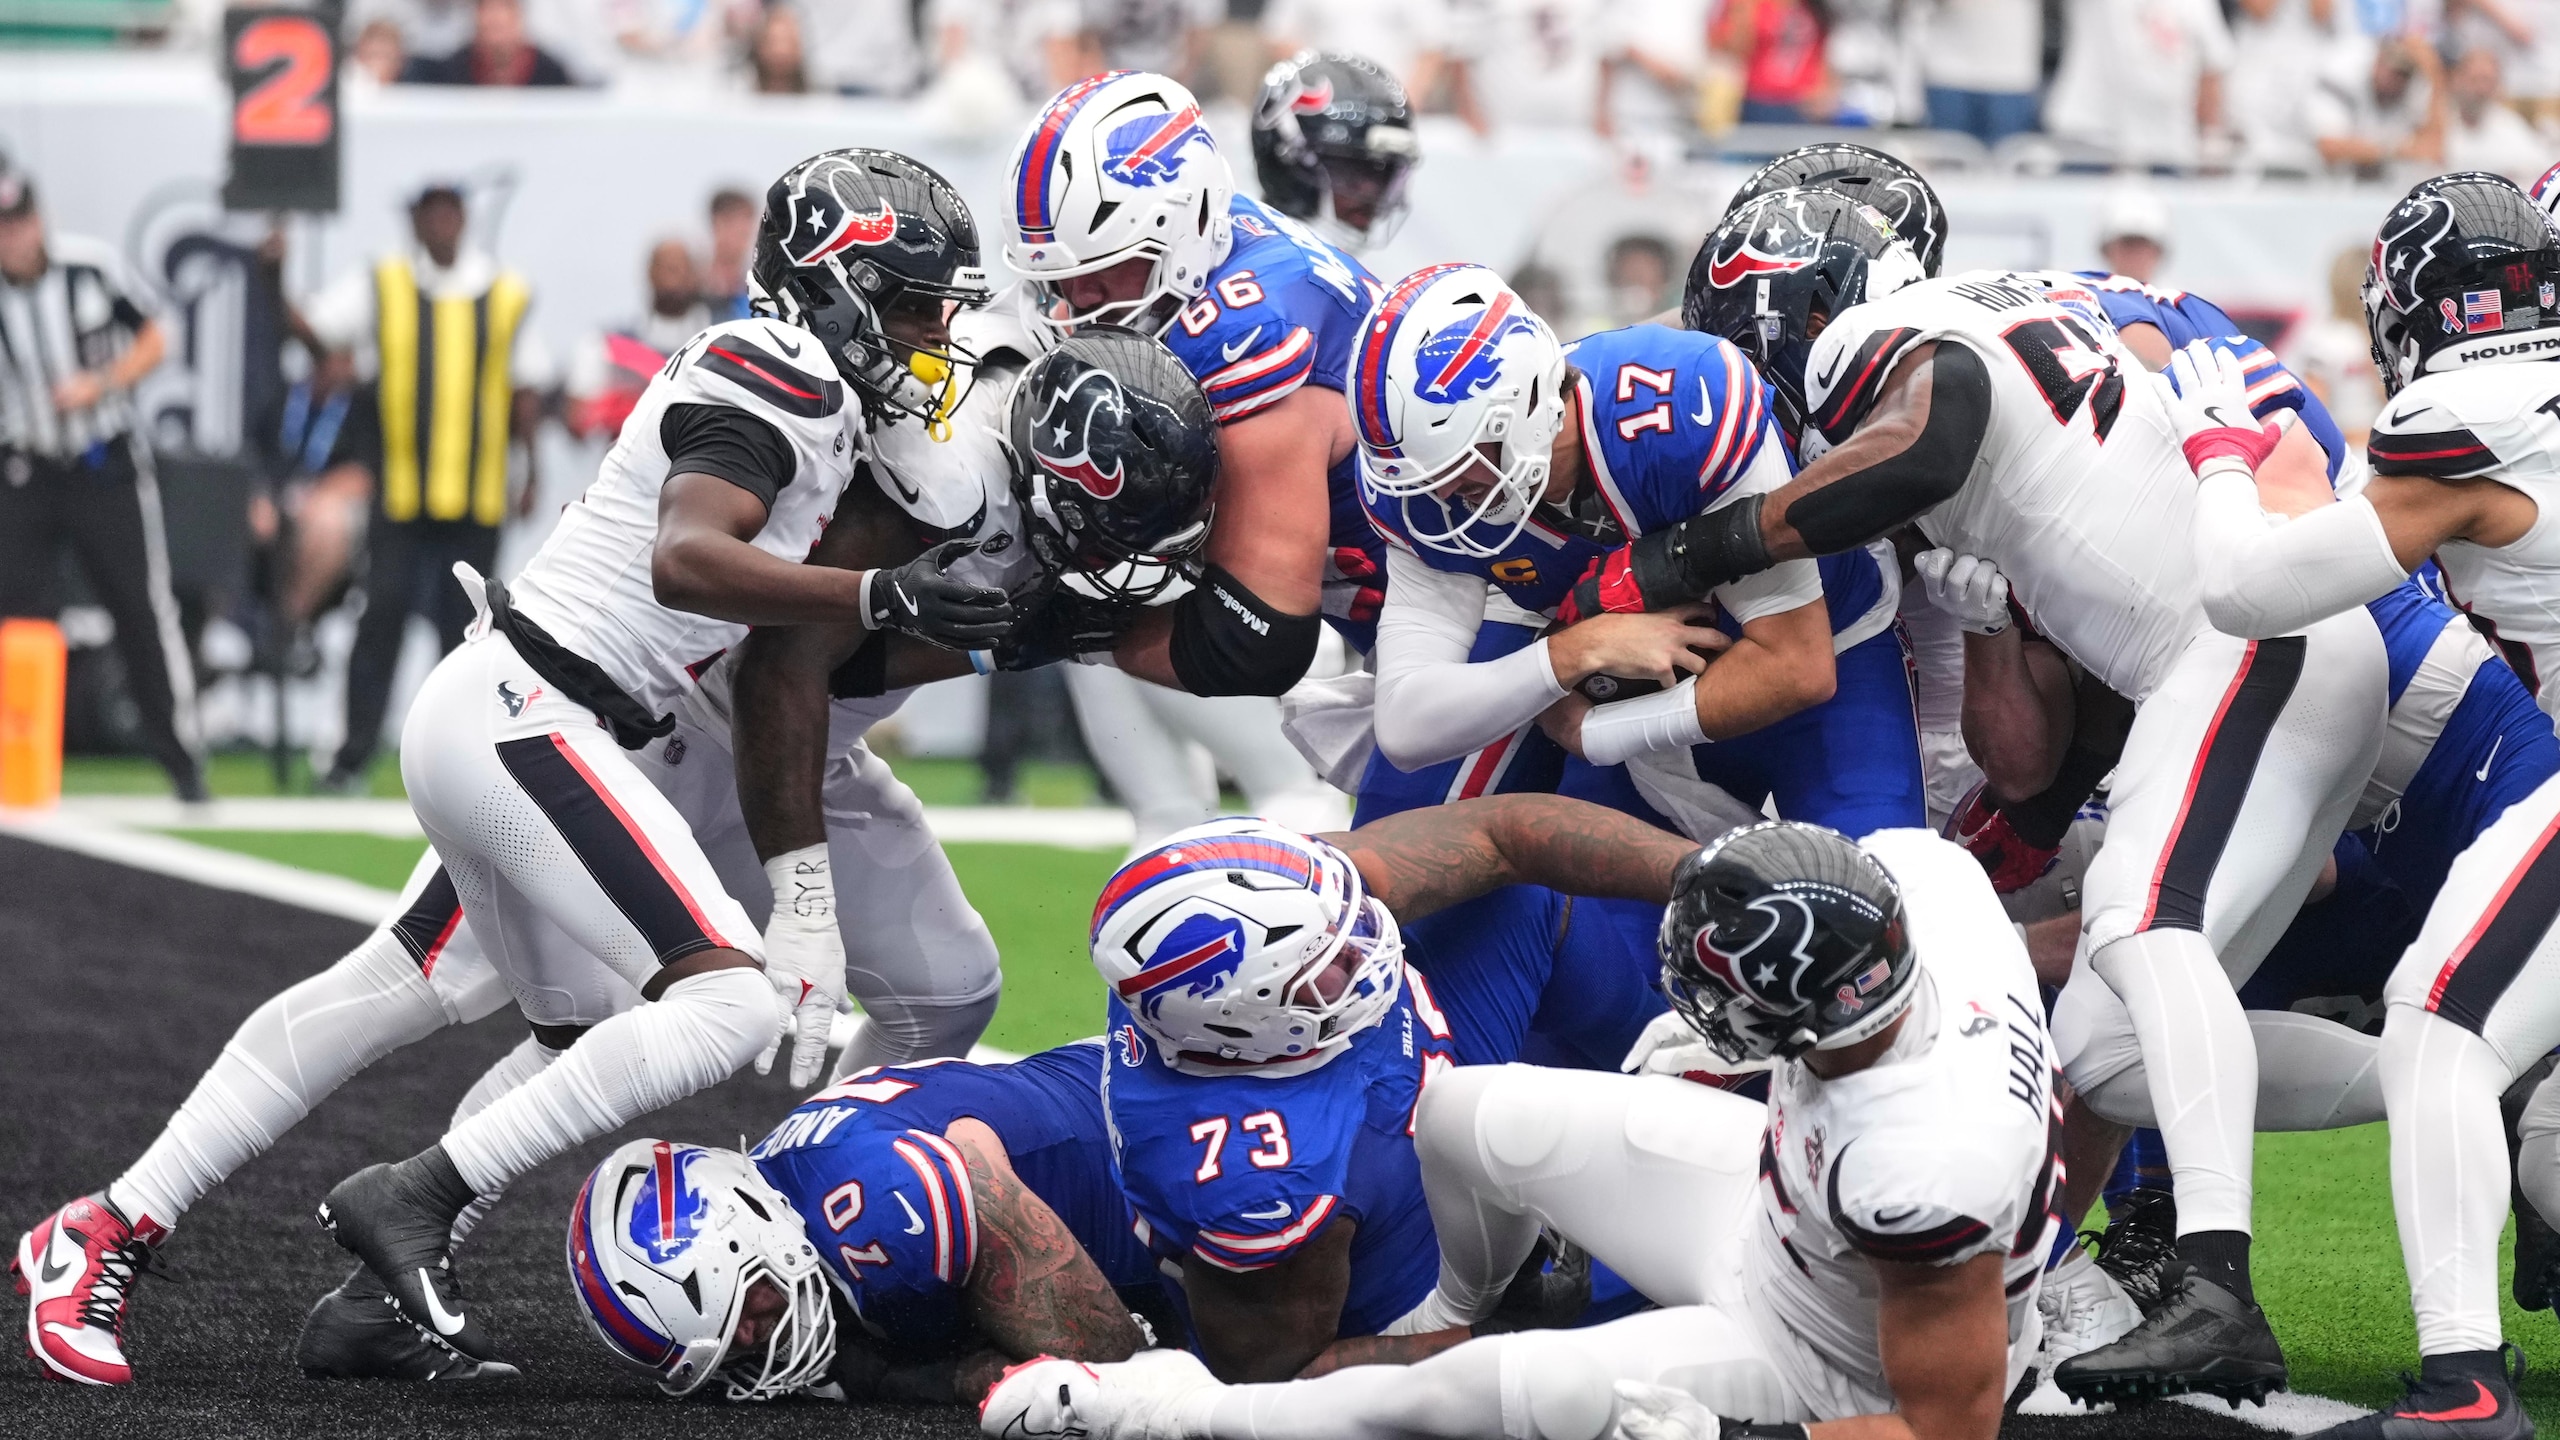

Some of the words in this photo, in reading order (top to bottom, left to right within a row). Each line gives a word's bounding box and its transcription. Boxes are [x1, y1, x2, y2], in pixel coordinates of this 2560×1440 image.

[234, 15, 331, 146] 2
[1178, 269, 1267, 337] 66
[1615, 363, 1676, 443] 17
[1213, 584, 1266, 632] Mueller
[1490, 558, 1538, 582] C
[1401, 1006, 1414, 1059] BILLS
[2007, 992, 2043, 1126] HALL
[1188, 1109, 1292, 1186] 73
[822, 1178, 892, 1282] 70
